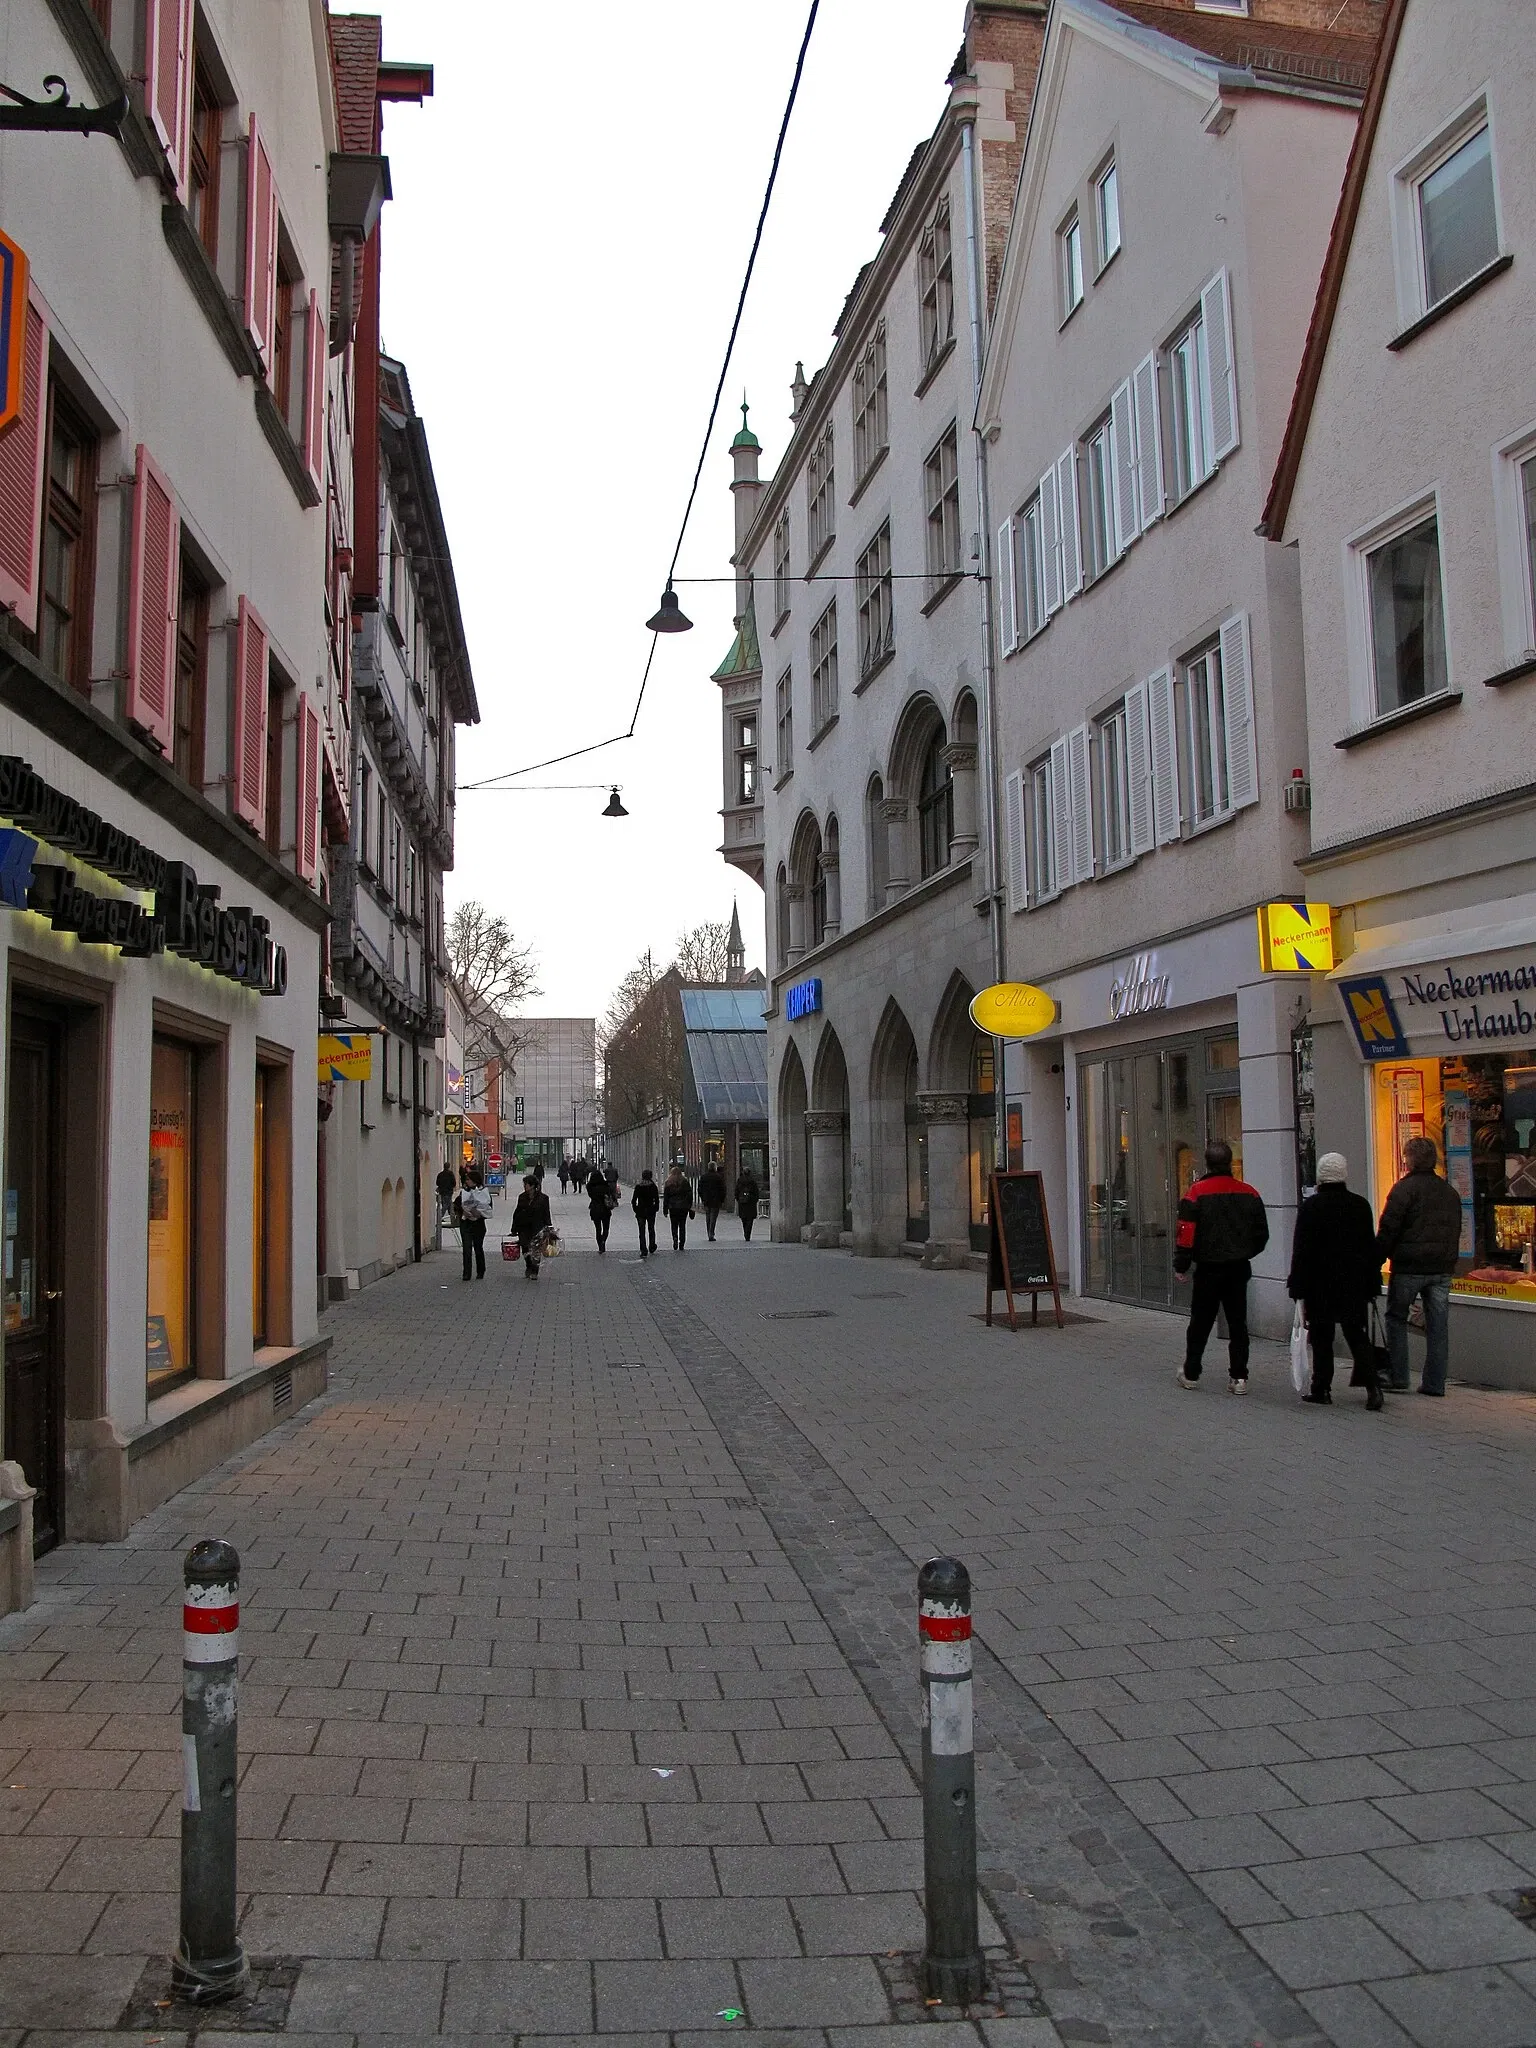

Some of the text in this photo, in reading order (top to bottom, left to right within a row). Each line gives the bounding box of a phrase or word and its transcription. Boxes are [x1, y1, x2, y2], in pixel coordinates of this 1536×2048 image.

[1273, 926, 1331, 947] Neckermann
[786, 978, 815, 1021] KEMPER
[995, 988, 1038, 1007] Alba
[1438, 999, 1536, 1041] Urlaub
[318, 1048, 372, 1065] eckermann
[1371, 1044, 1396, 1053] Partner
[515, 1097, 523, 1124] JUNG
[1449, 1281, 1507, 1296] acht's möglich
